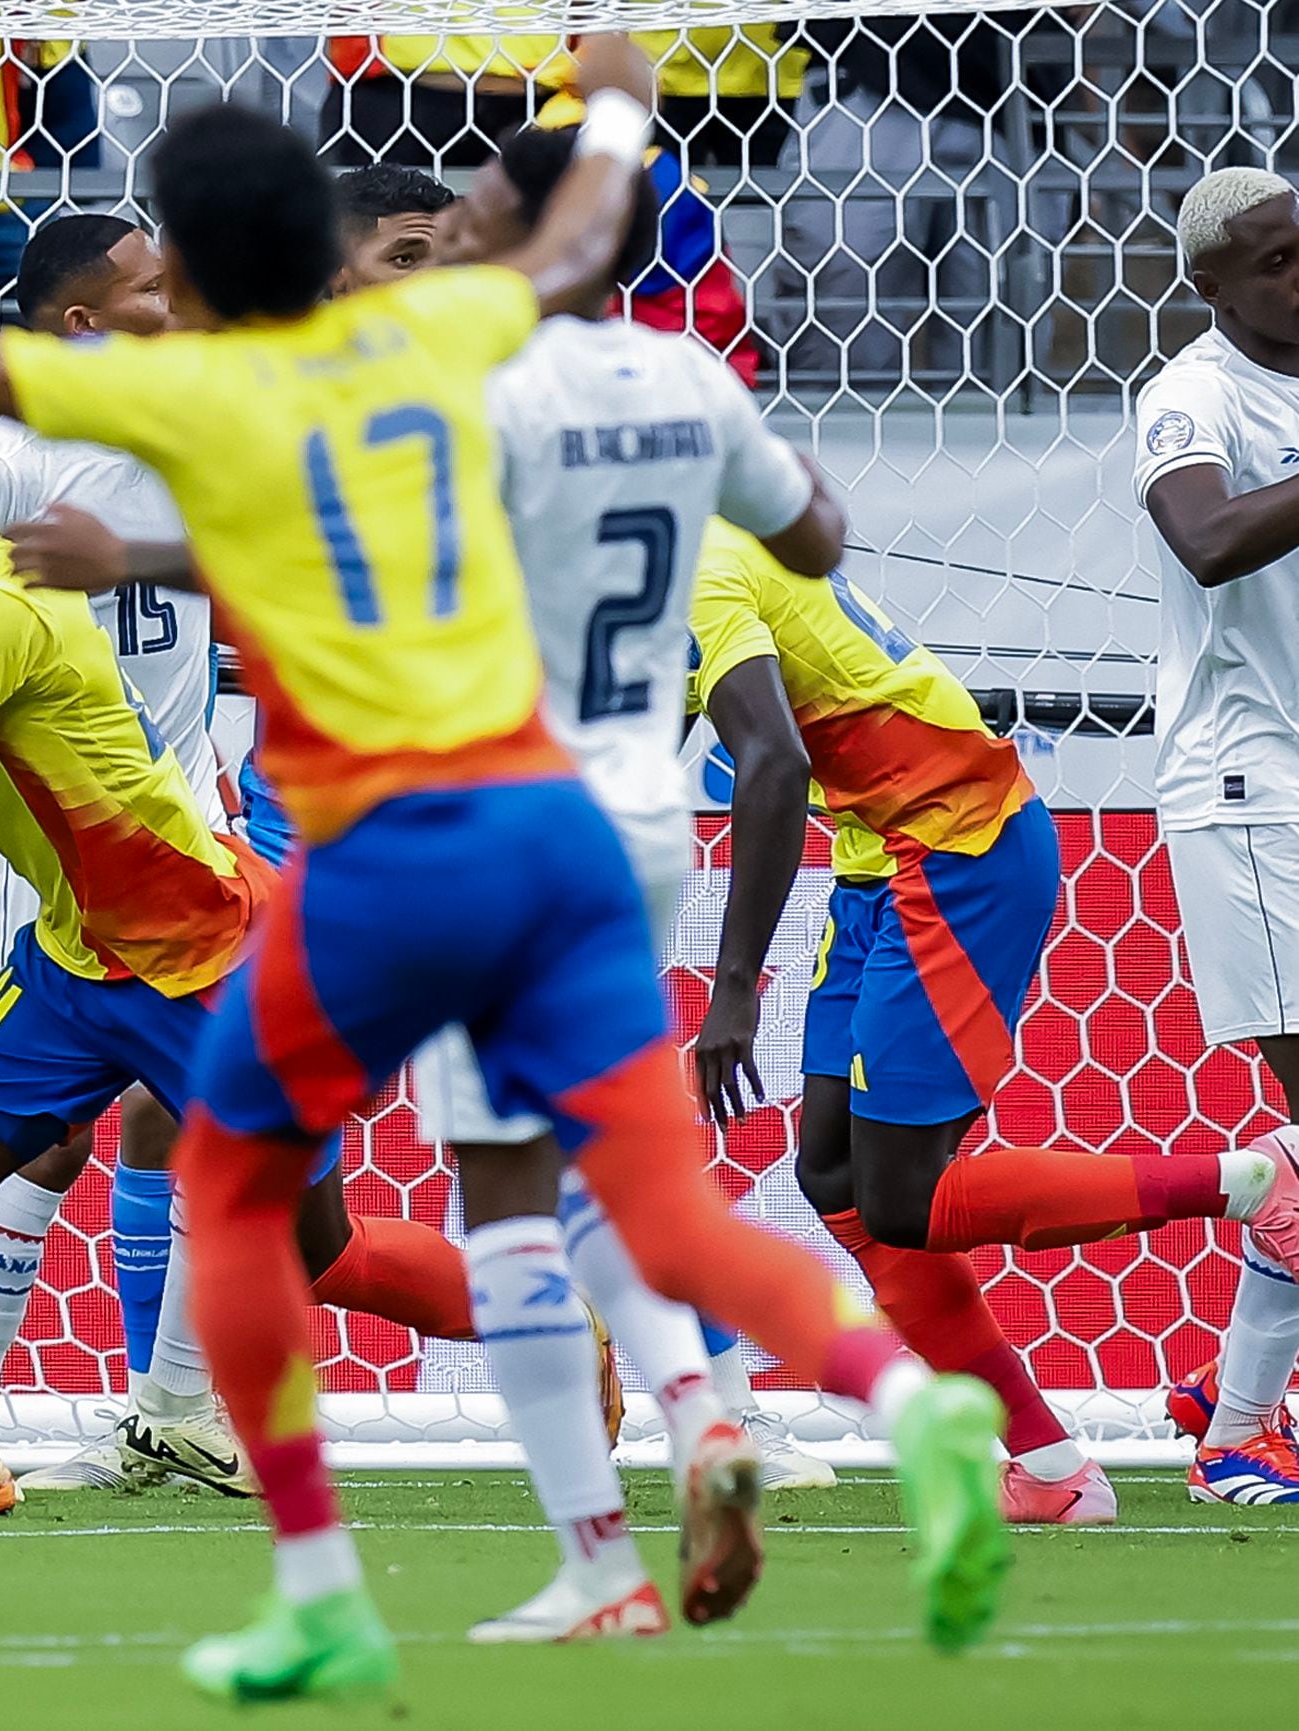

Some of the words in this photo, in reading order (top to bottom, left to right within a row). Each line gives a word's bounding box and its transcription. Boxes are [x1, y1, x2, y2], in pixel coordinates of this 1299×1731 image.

[114, 582, 177, 656] 15
[305, 403, 458, 624] 17
[578, 506, 675, 724] 2
